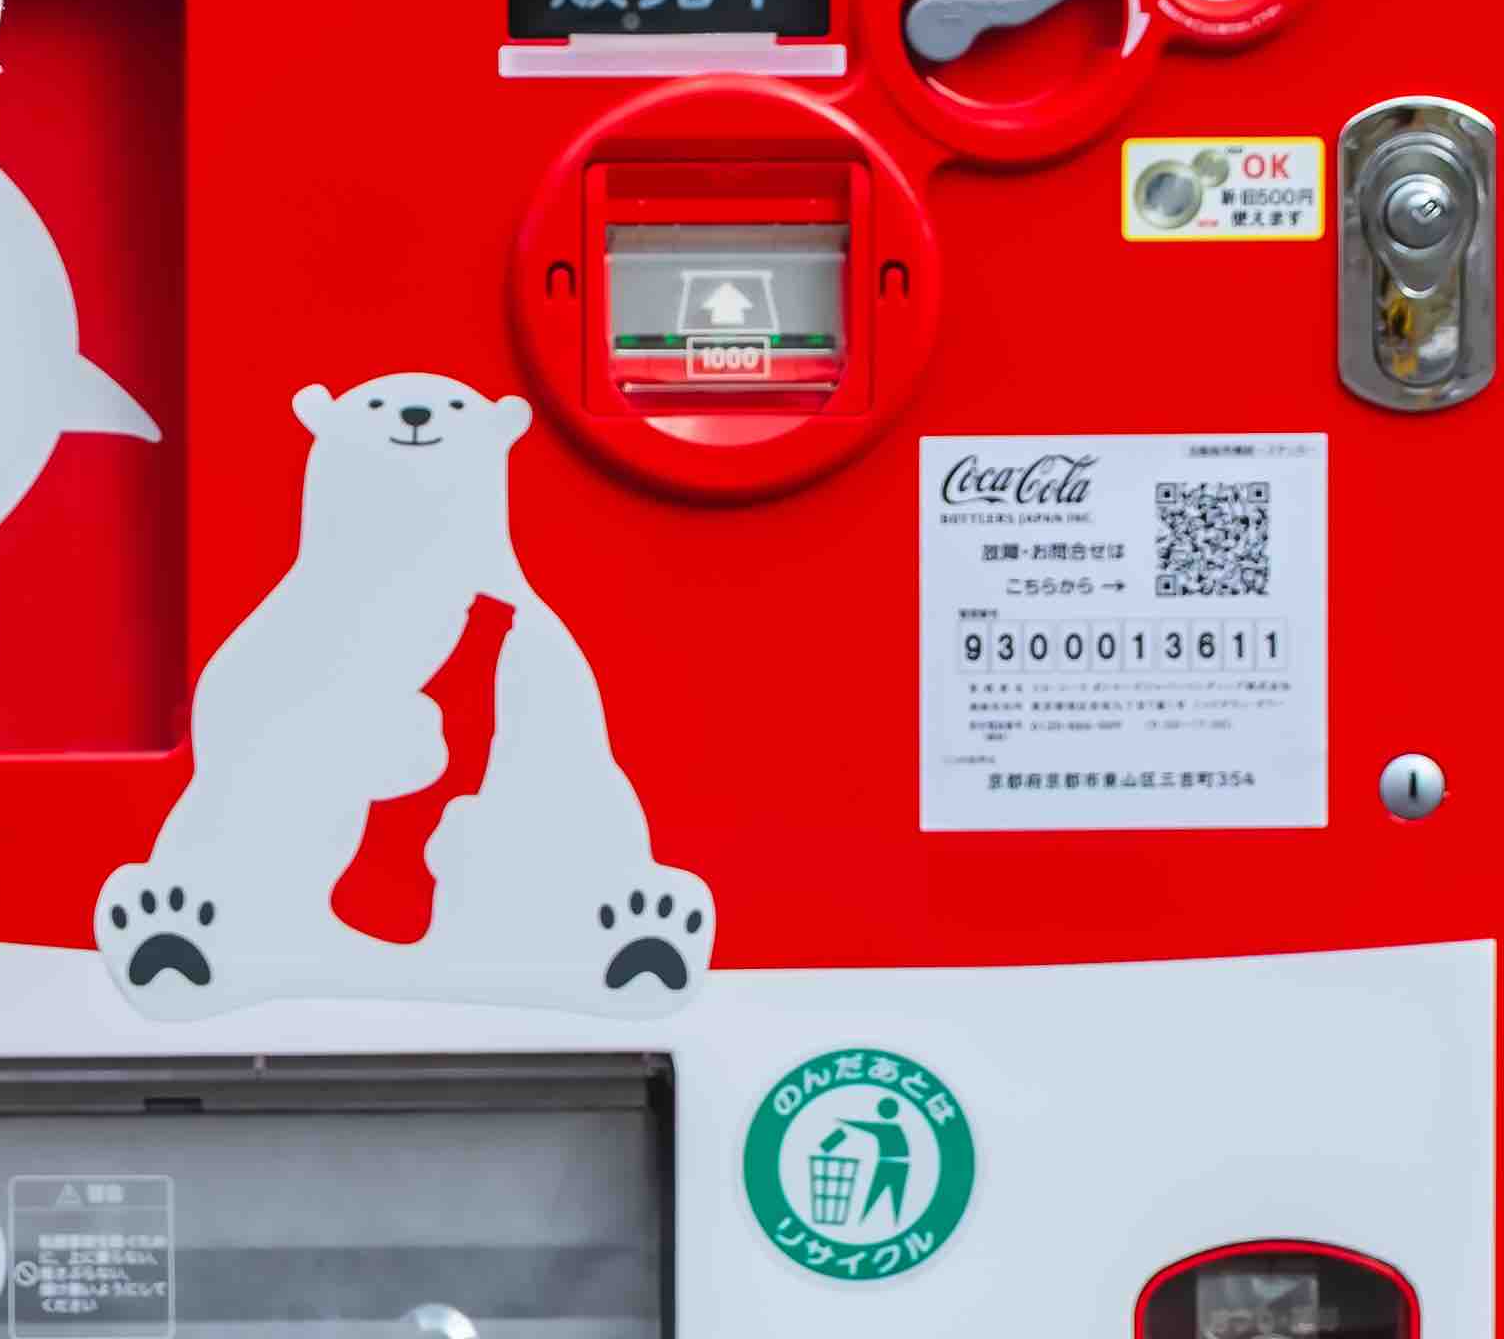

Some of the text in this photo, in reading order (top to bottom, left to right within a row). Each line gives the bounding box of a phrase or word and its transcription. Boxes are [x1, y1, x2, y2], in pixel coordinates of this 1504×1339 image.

[1242, 153, 1290, 180] OK
[1232, 209, 1302, 228] 使えます
[698, 346, 759, 371] 1000
[939, 453, 1100, 506] Coca-Cola
[939, 513, 1014, 526] BOTTLERS
[1019, 513, 1062, 526] JAPAN
[981, 543, 1126, 562] 故障・お問合せは
[1006, 577, 1094, 596] こちらから
[772, 1052, 957, 1127] のんだあとは
[775, 1216, 935, 1276] リサイクル
